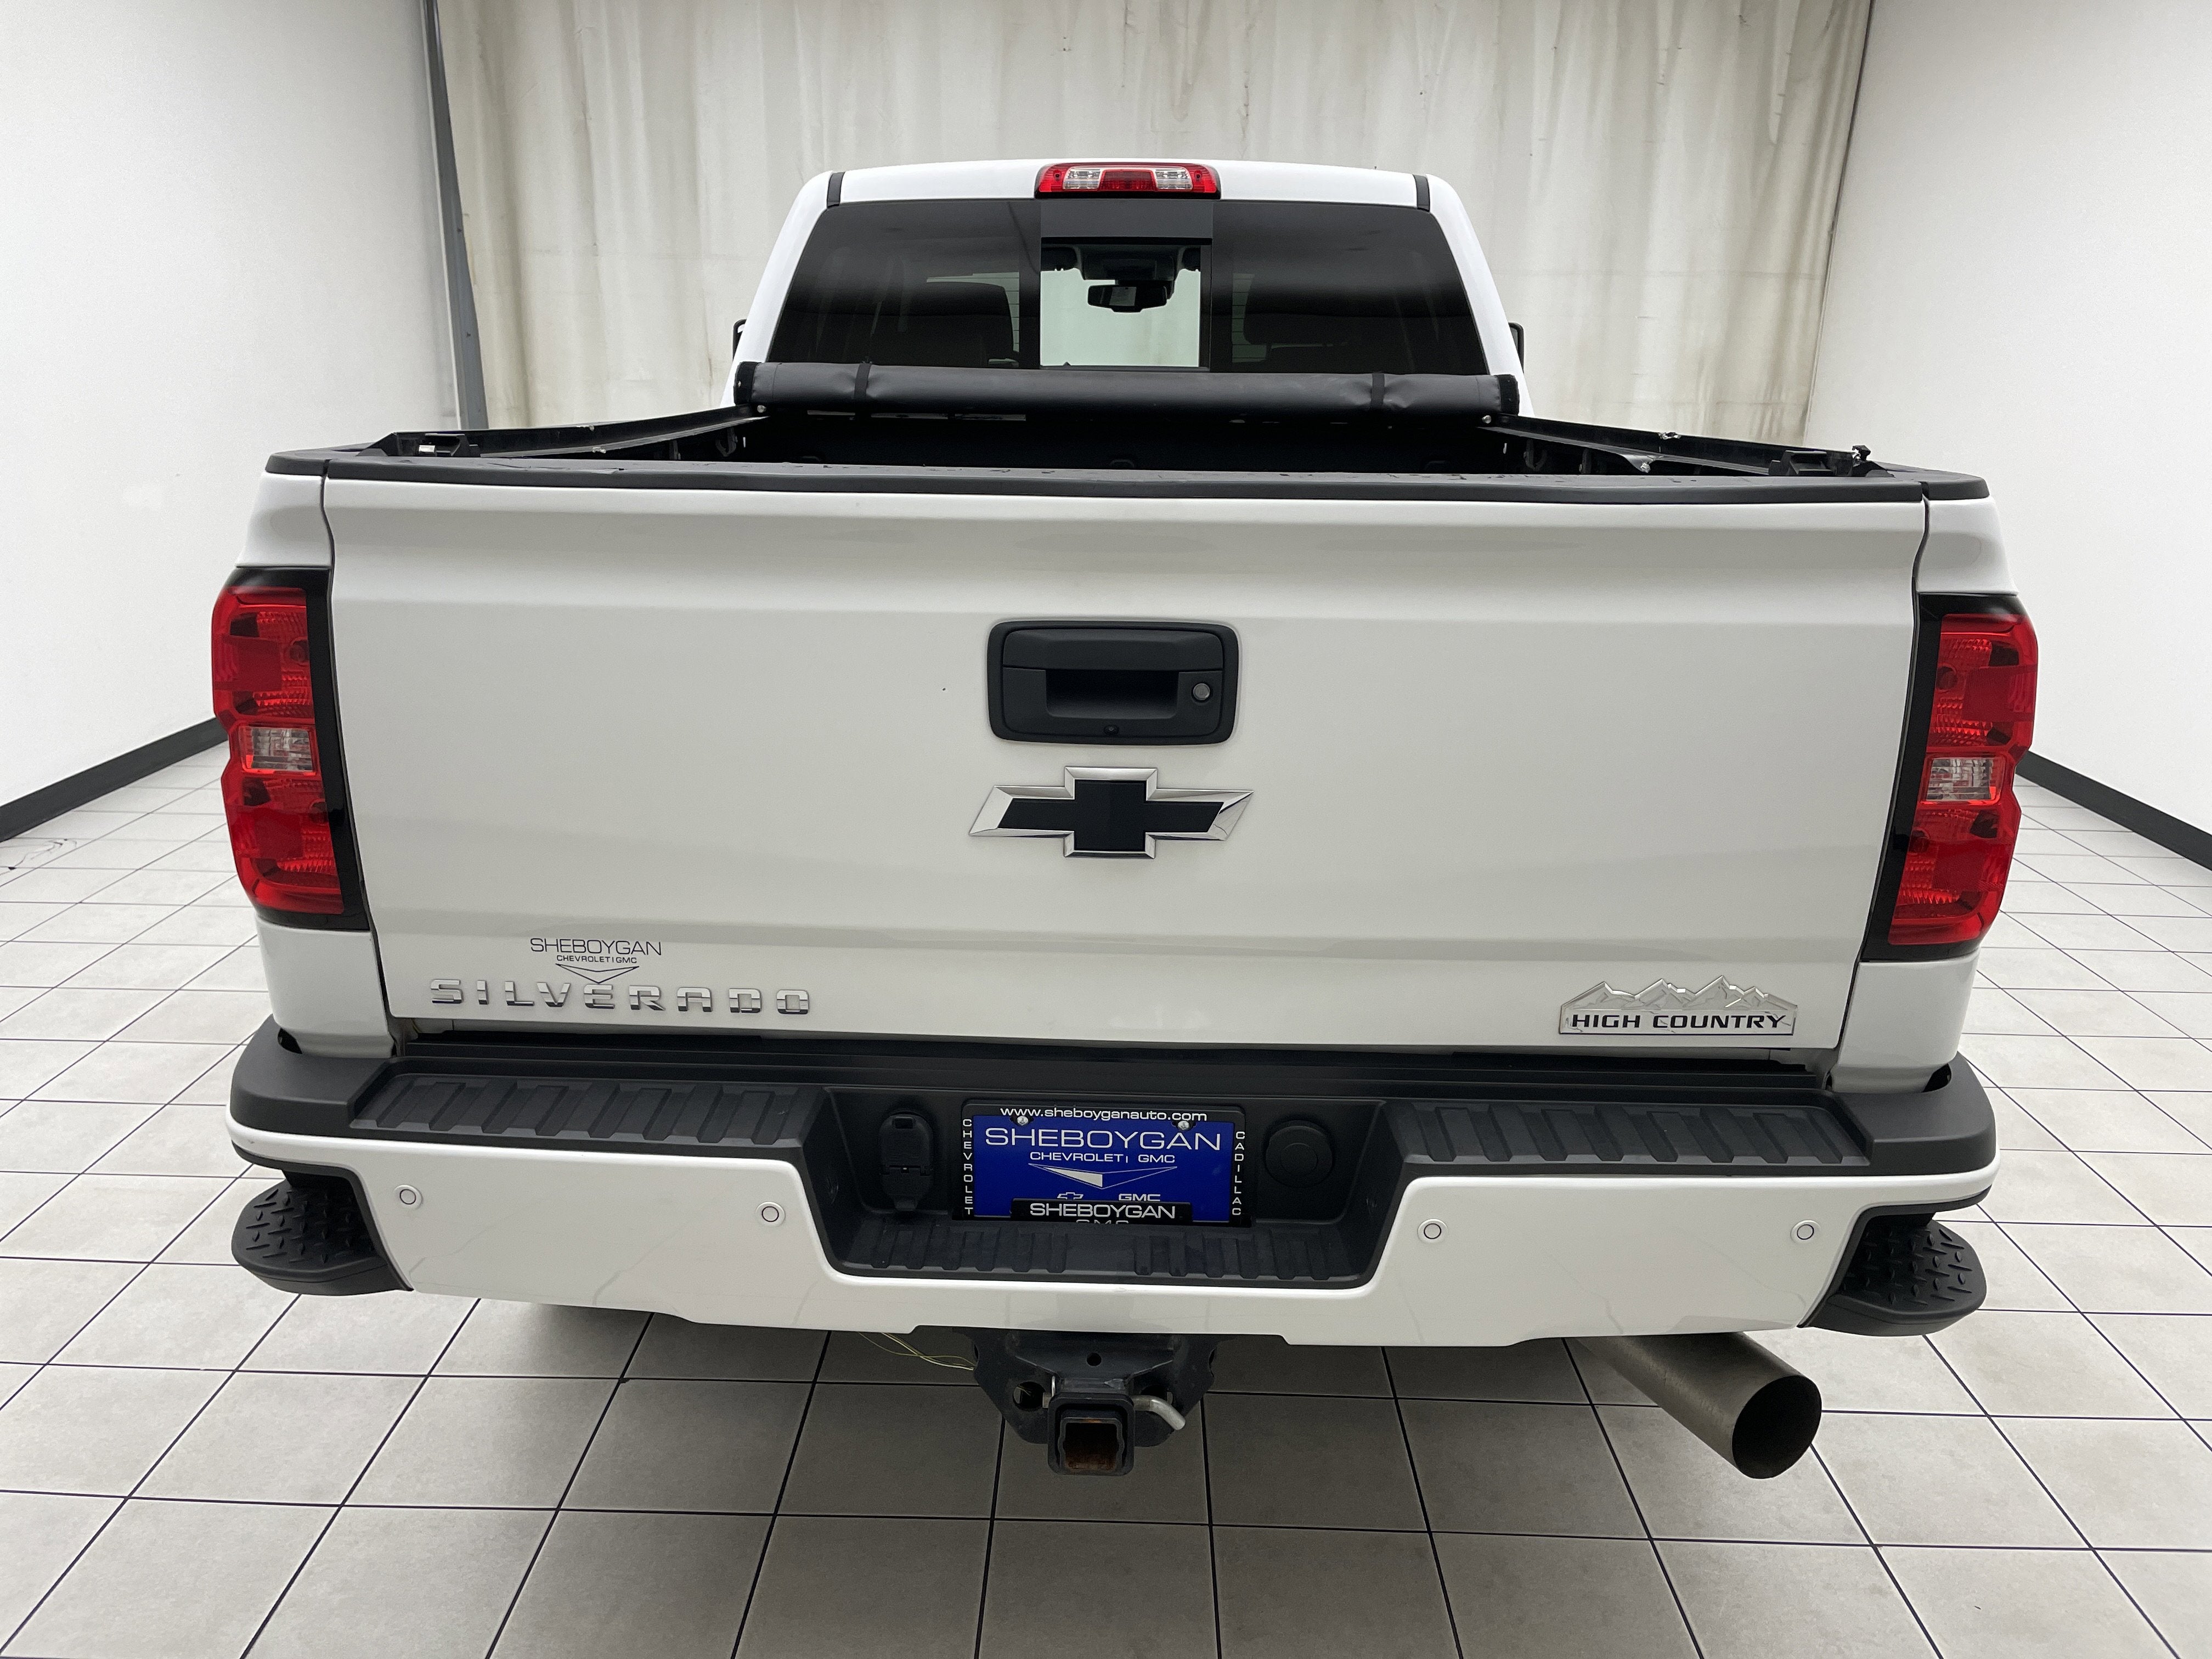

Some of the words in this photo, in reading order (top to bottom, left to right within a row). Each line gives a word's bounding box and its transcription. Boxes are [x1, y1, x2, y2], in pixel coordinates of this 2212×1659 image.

[530, 938, 662, 956] SHEBOYGAN
[556, 955, 611, 963] CHEVROLET
[431, 979, 810, 1015] SILVERADO
[1572, 1014, 1640, 1028] HIGH
[1653, 1015, 1786, 1029] COUNTRY
[1000, 1107, 1207, 1121] www.sheboyganauto.com
[985, 1127, 1221, 1150] SHEBOYGAN
[1030, 1152, 1124, 1163] CHEVROLET
[1138, 1154, 1175, 1163] GMC
[962, 1119, 973, 1215] CHEVROLET
[1232, 1131, 1245, 1216] CADILLAC
[1119, 1193, 1161, 1202] GMC
[1030, 1203, 1176, 1219] SHEBOYGAN
